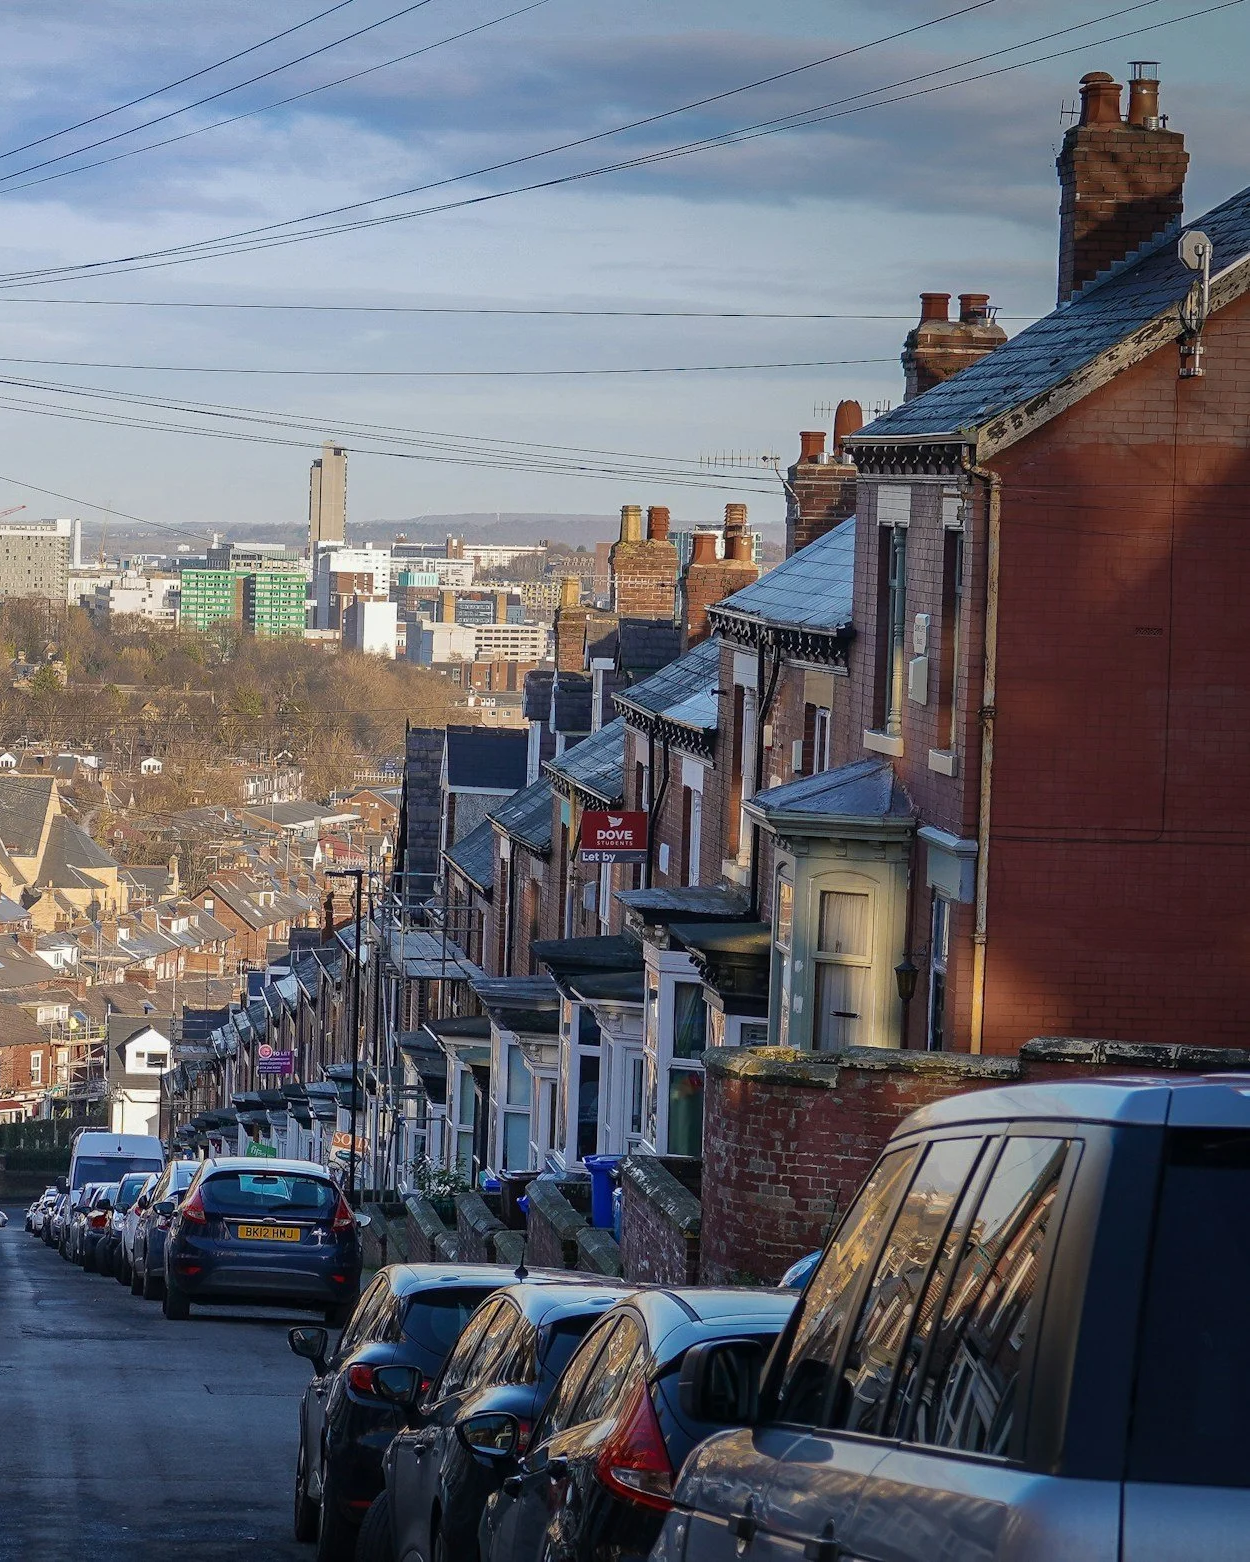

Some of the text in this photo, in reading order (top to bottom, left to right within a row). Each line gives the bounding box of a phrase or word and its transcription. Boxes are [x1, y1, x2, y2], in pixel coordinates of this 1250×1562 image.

[596, 830, 633, 840] DOVE
[582, 852, 600, 862] Let
[602, 852, 616, 863] by
[333, 1131, 369, 1149] SOD
[245, 1227, 270, 1238] BK12
